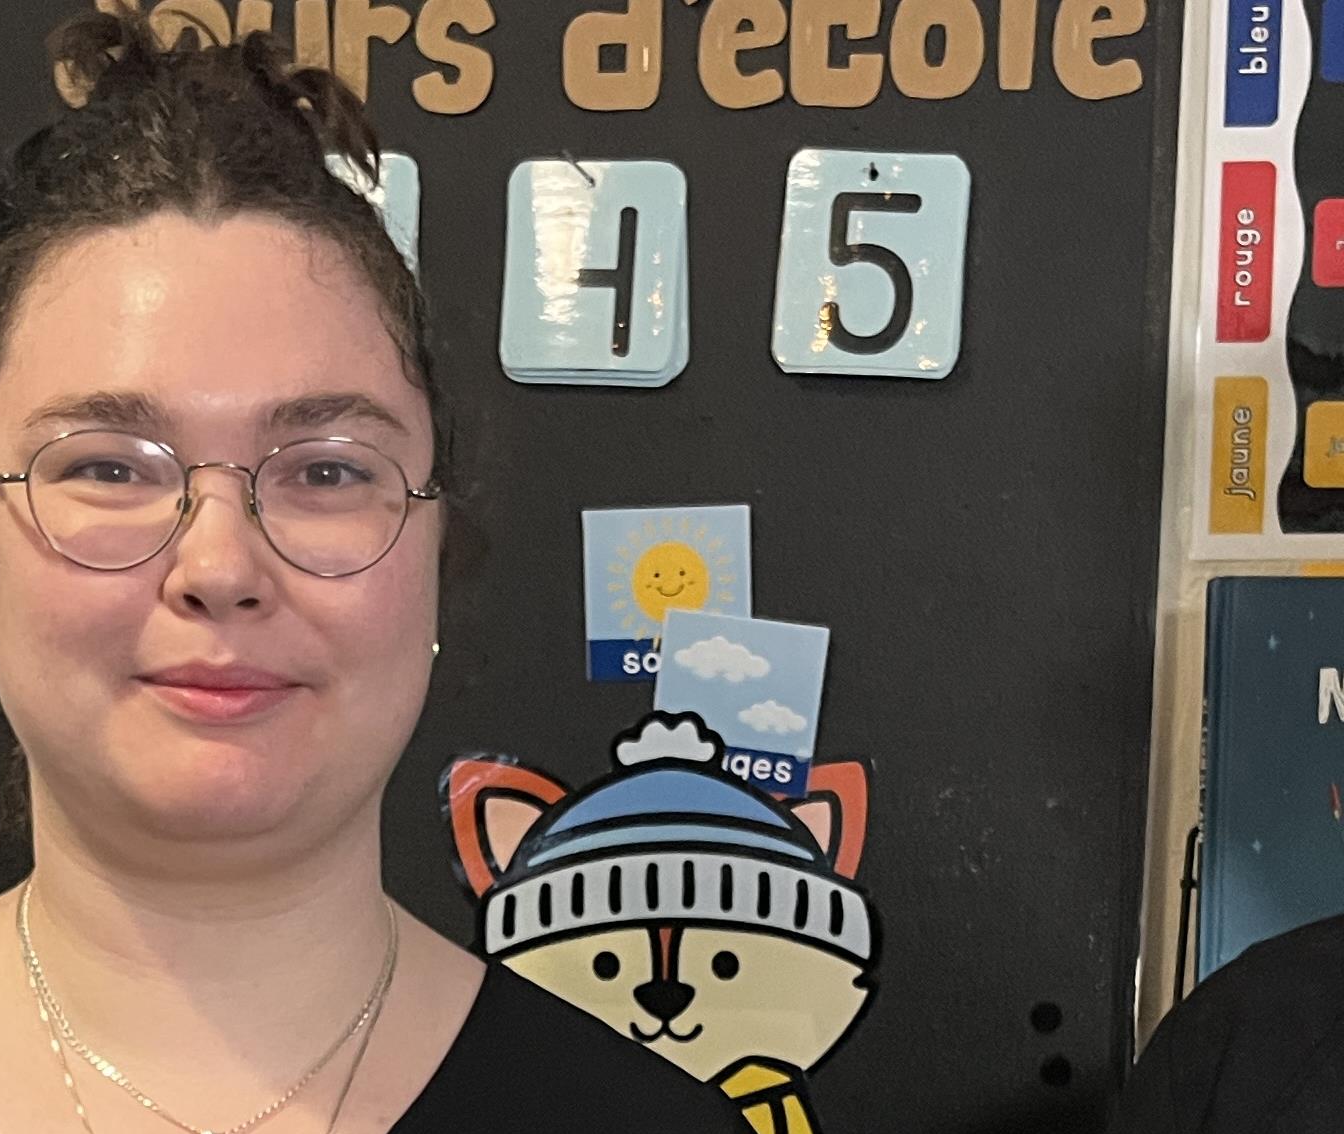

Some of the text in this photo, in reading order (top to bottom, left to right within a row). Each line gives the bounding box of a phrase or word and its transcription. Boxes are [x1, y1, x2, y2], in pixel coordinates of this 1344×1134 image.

[1239, 5, 1269, 74] bleu
[821, 191, 922, 355] 5
[1233, 208, 1261, 308] rouge
[1224, 406, 1255, 499] jaune
